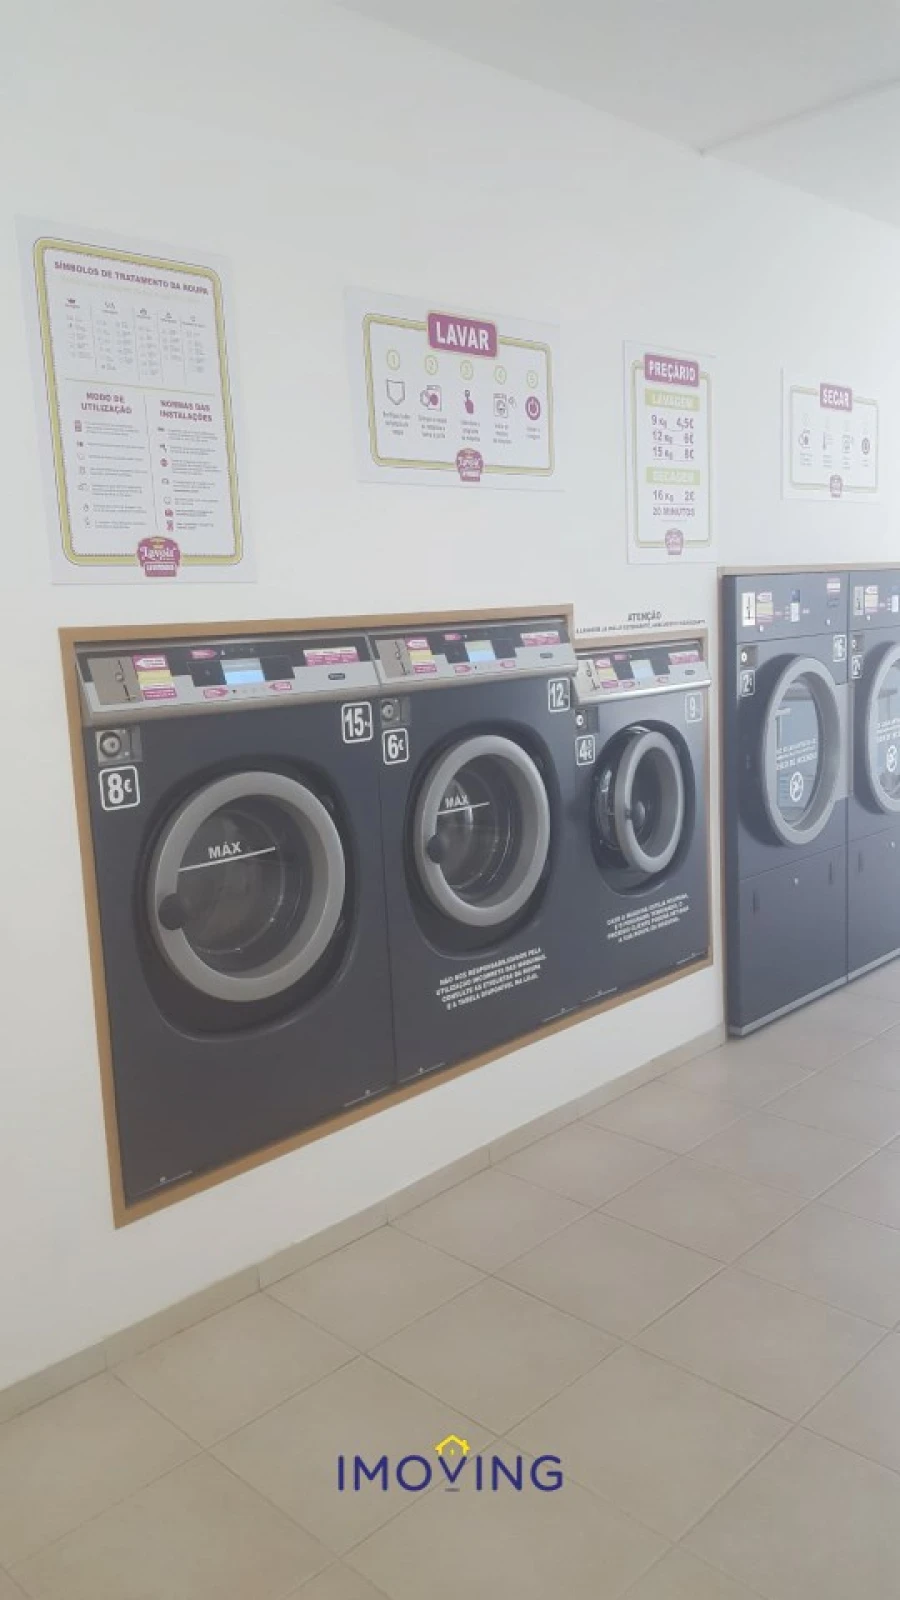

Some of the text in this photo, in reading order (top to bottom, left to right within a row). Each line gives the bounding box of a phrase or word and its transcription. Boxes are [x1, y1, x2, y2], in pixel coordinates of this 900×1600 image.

[54, 260, 99, 276] SÍMBOLOS
[101, 269, 113, 279] DE
[114, 271, 169, 288] TRATAMENTO
[436, 321, 489, 351] LAVAR
[649, 360, 696, 382] PREÇÁRIO
[822, 388, 850, 408] SECAR
[81, 403, 133, 415] UTILIZAÇÃO
[159, 409, 213, 423] INSTALAÇÕES
[628, 610, 661, 622] ATENÇÃO
[387, 734, 403, 759] 6€
[107, 772, 132, 804] 8€
[207, 841, 242, 859] MÁX
